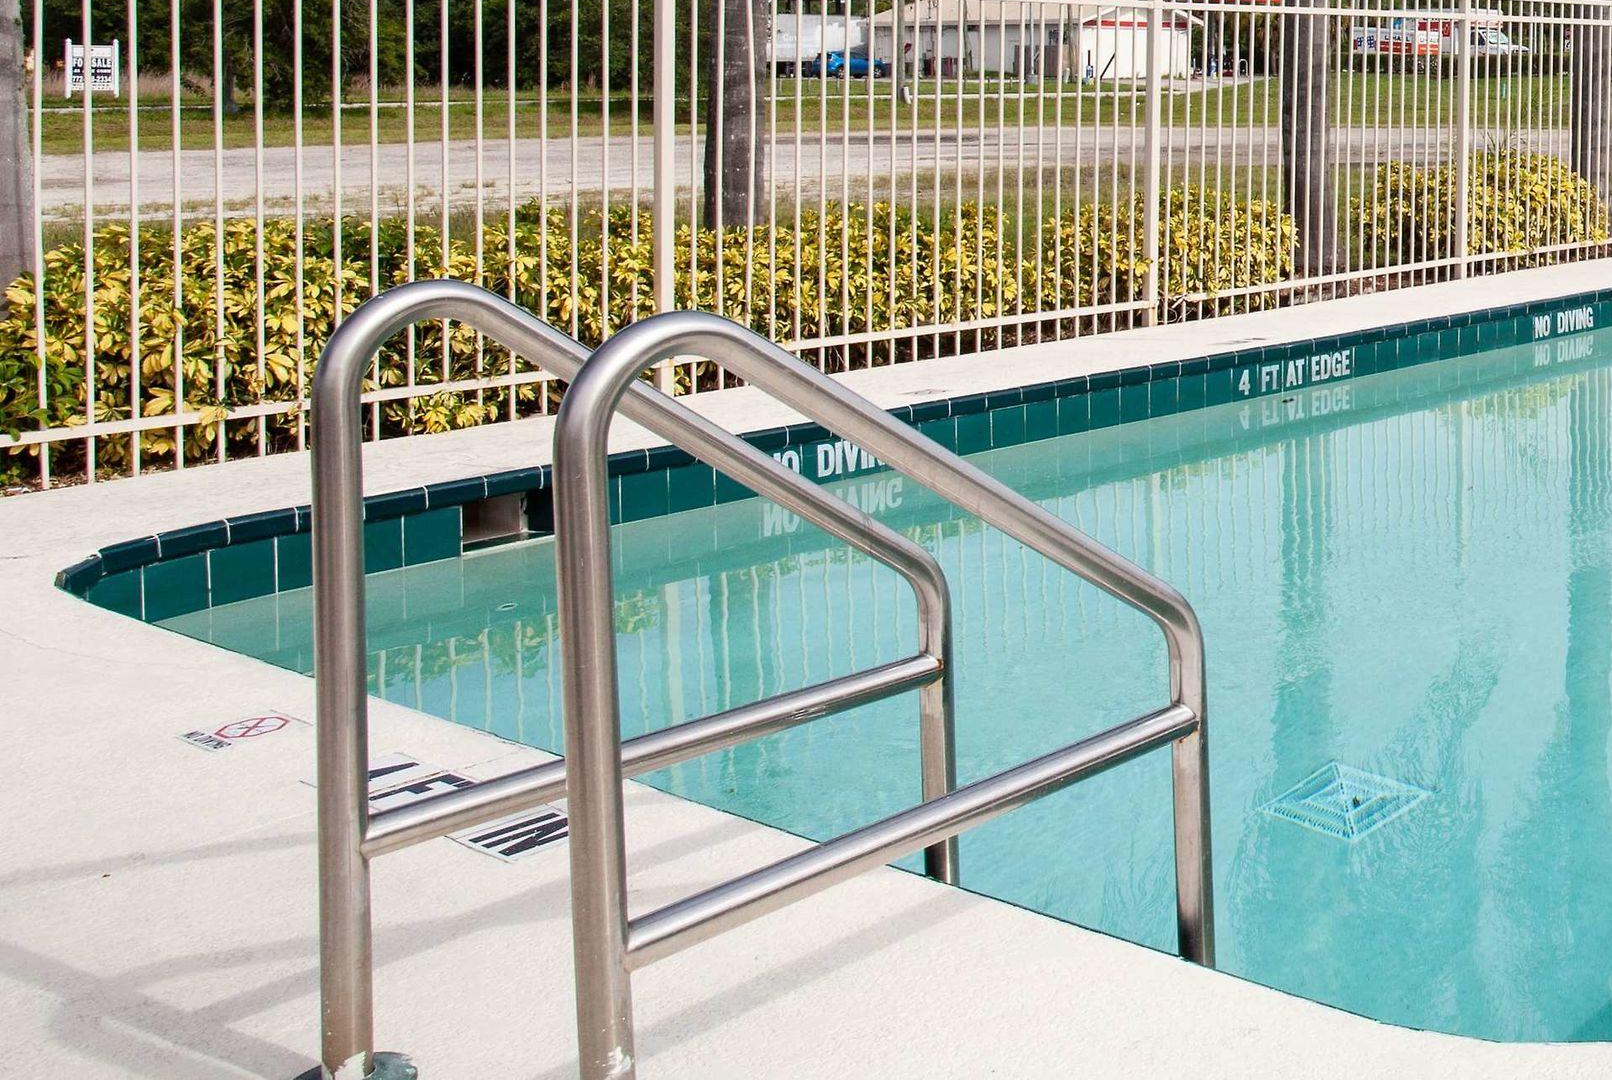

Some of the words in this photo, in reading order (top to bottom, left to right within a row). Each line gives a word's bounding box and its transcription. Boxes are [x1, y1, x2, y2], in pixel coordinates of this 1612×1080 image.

[73, 58, 86, 68] FO
[92, 58, 112, 68] SALE
[1534, 315, 1551, 338] NO
[1557, 306, 1594, 333] DIVING
[1239, 369, 1250, 395] 4
[1261, 364, 1279, 392] FT
[1286, 359, 1305, 387] AT
[1311, 350, 1350, 381] EDGE
